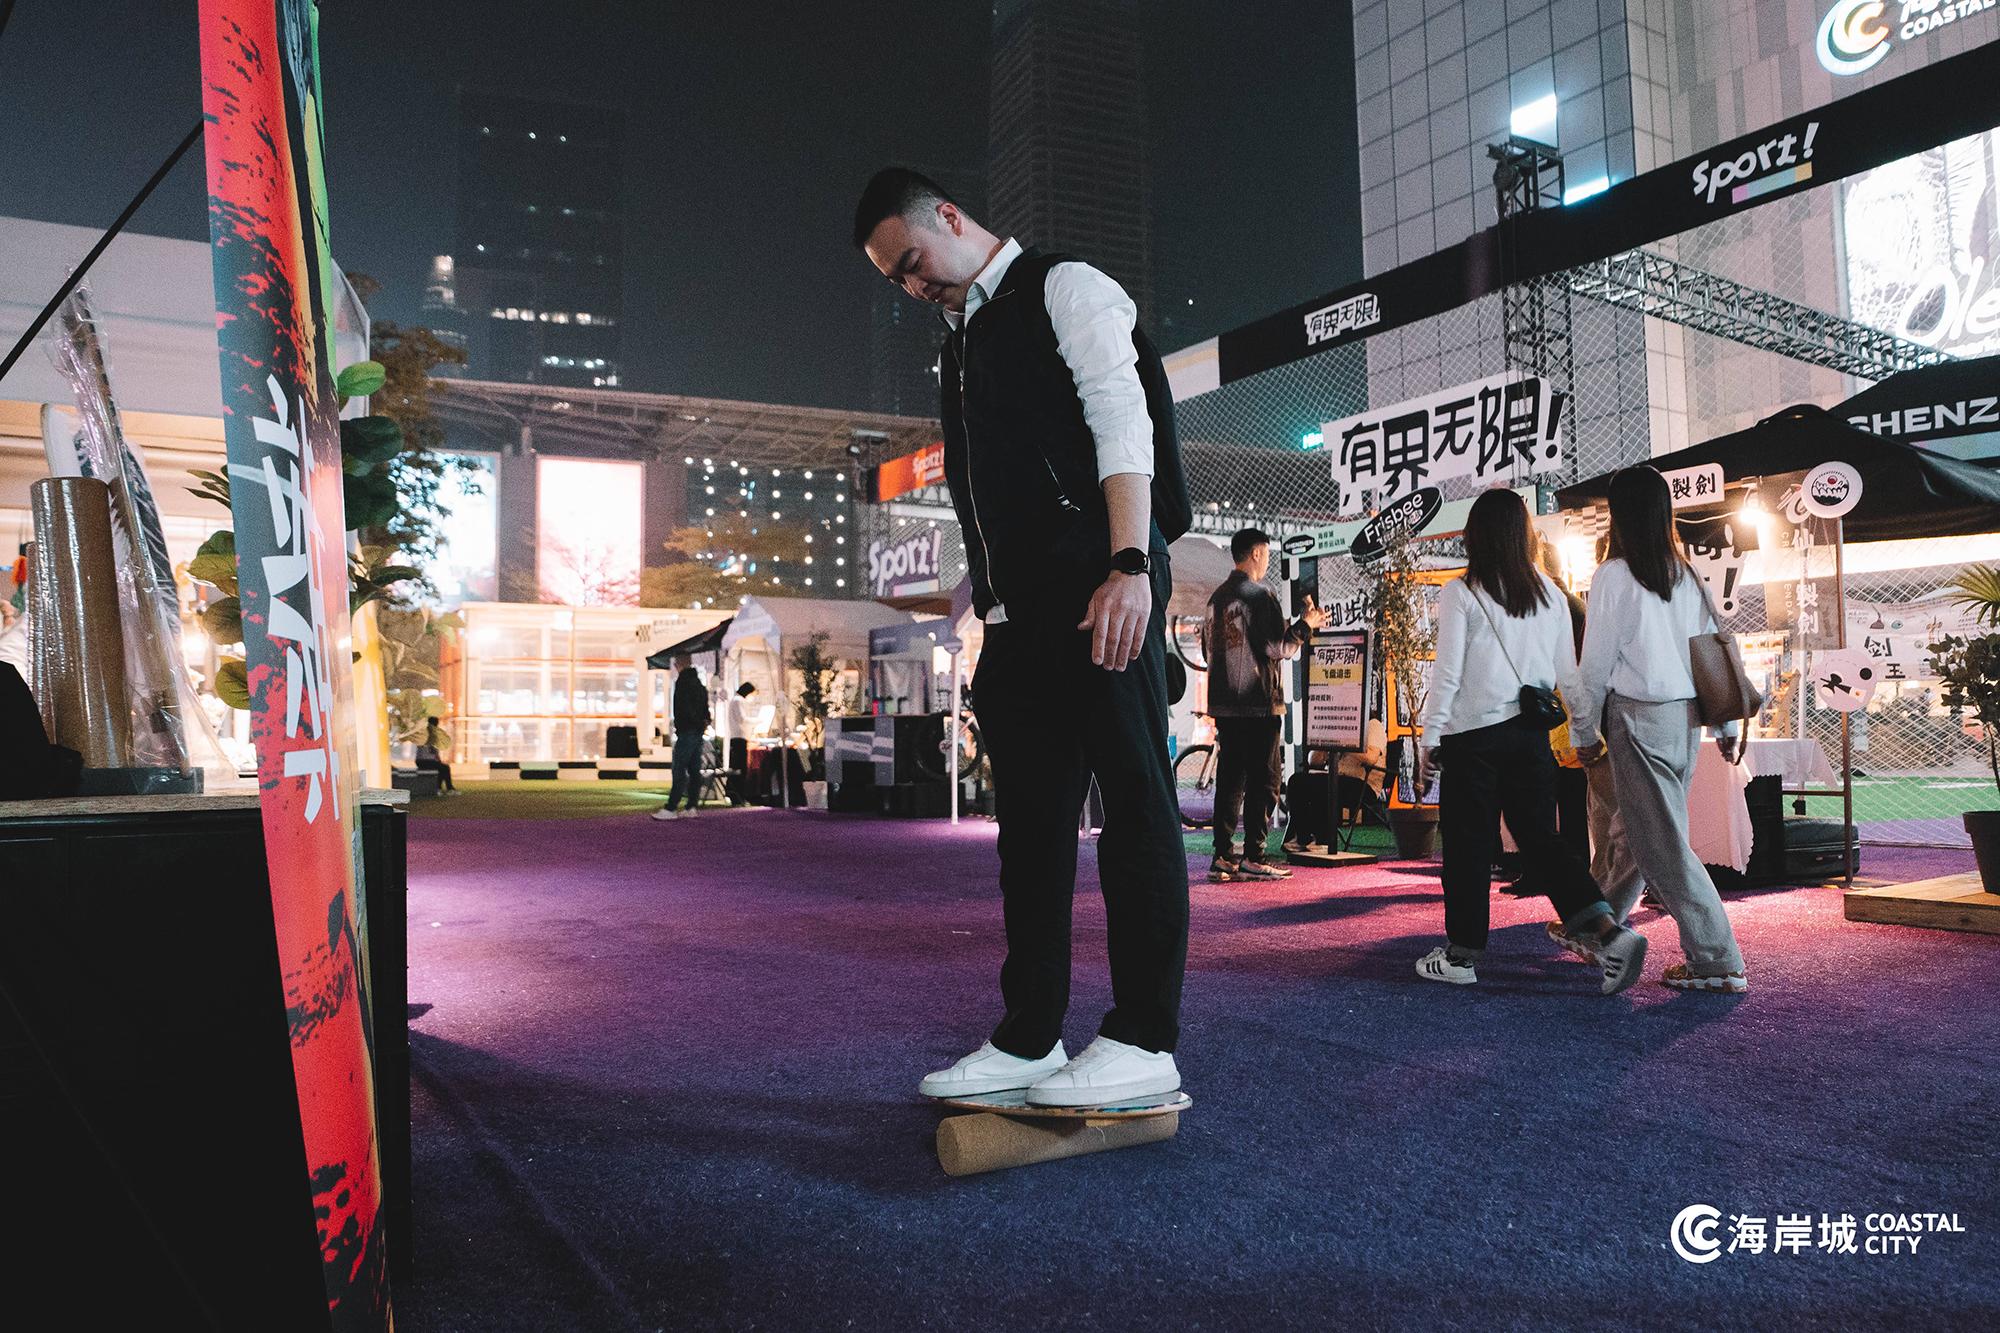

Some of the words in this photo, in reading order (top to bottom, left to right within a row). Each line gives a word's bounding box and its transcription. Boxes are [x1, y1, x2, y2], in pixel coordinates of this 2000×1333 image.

[1693, 122, 1820, 204] Sport!
[1308, 294, 1379, 342] 有界无限!
[1340, 376, 1566, 507] 有界无限!
[1363, 492, 1425, 544] Frisbee
[868, 528, 942, 598] Sport!
